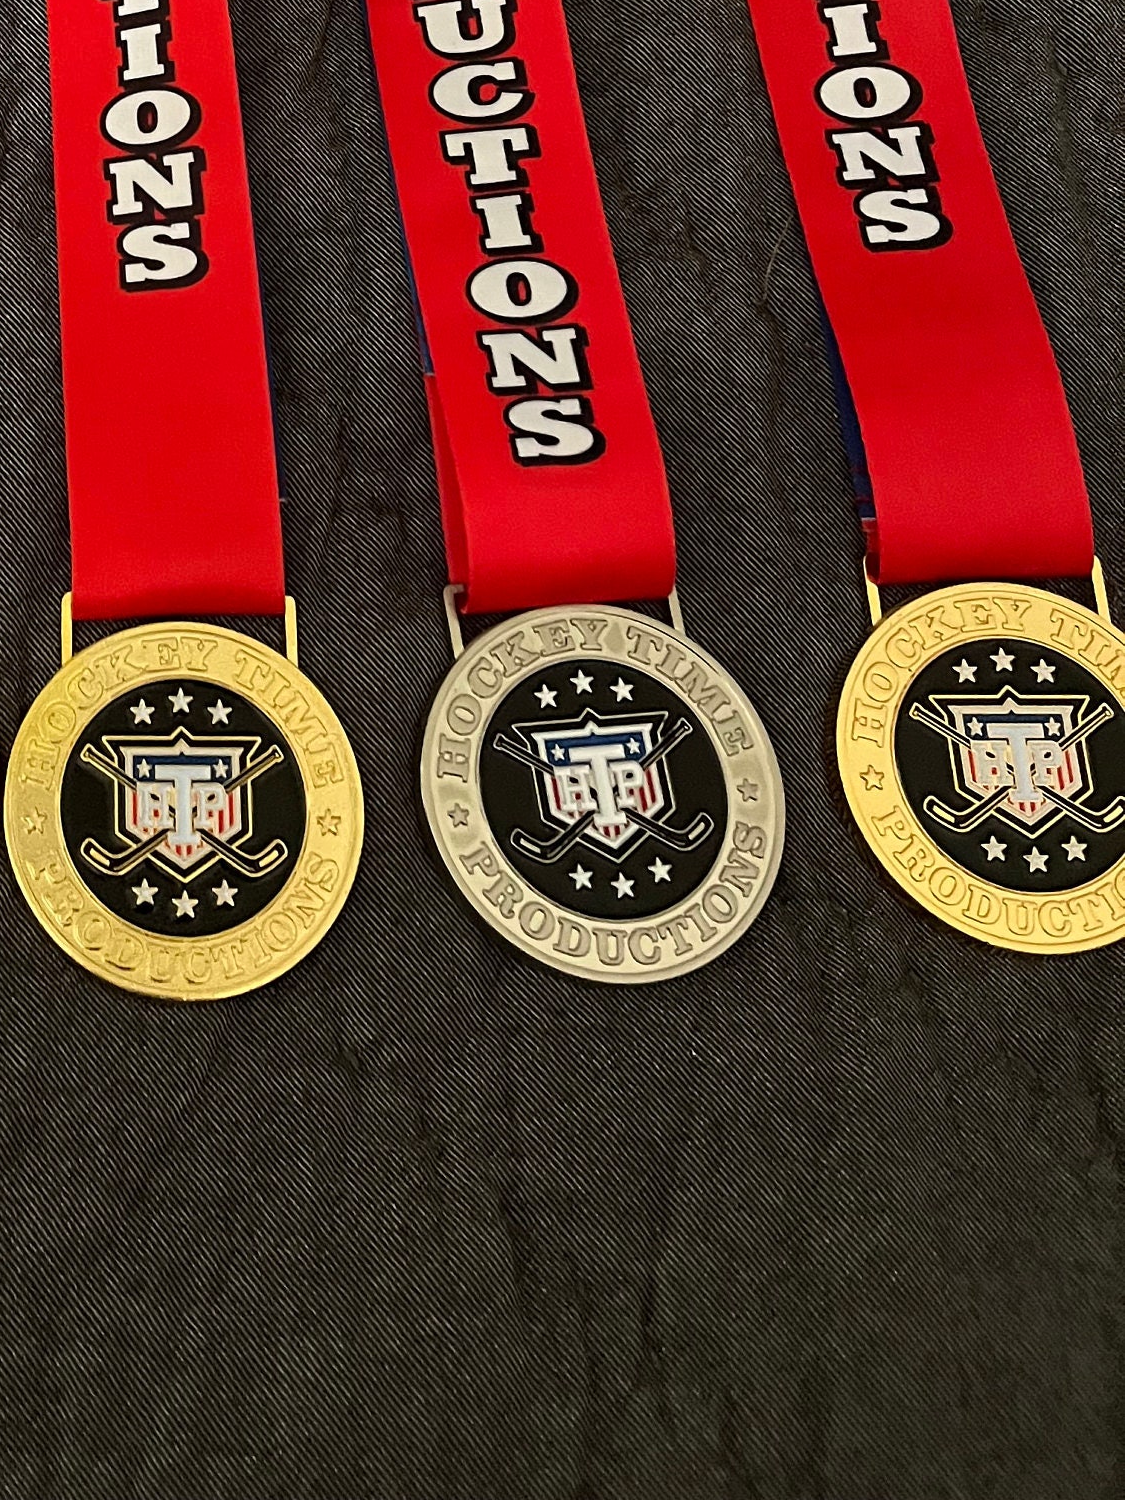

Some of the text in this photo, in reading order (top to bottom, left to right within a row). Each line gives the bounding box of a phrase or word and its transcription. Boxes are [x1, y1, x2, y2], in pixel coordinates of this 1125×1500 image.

[19, 636, 347, 792] HOCKEY TIME
[437, 617, 755, 783] HOCKEY TIME
[852, 596, 1032, 749] HOCKEY
[24, 850, 341, 985] PRODUCTIONS
[459, 820, 767, 967] PRODUCTIONS
[871, 805, 1125, 937] PRODUCTI
